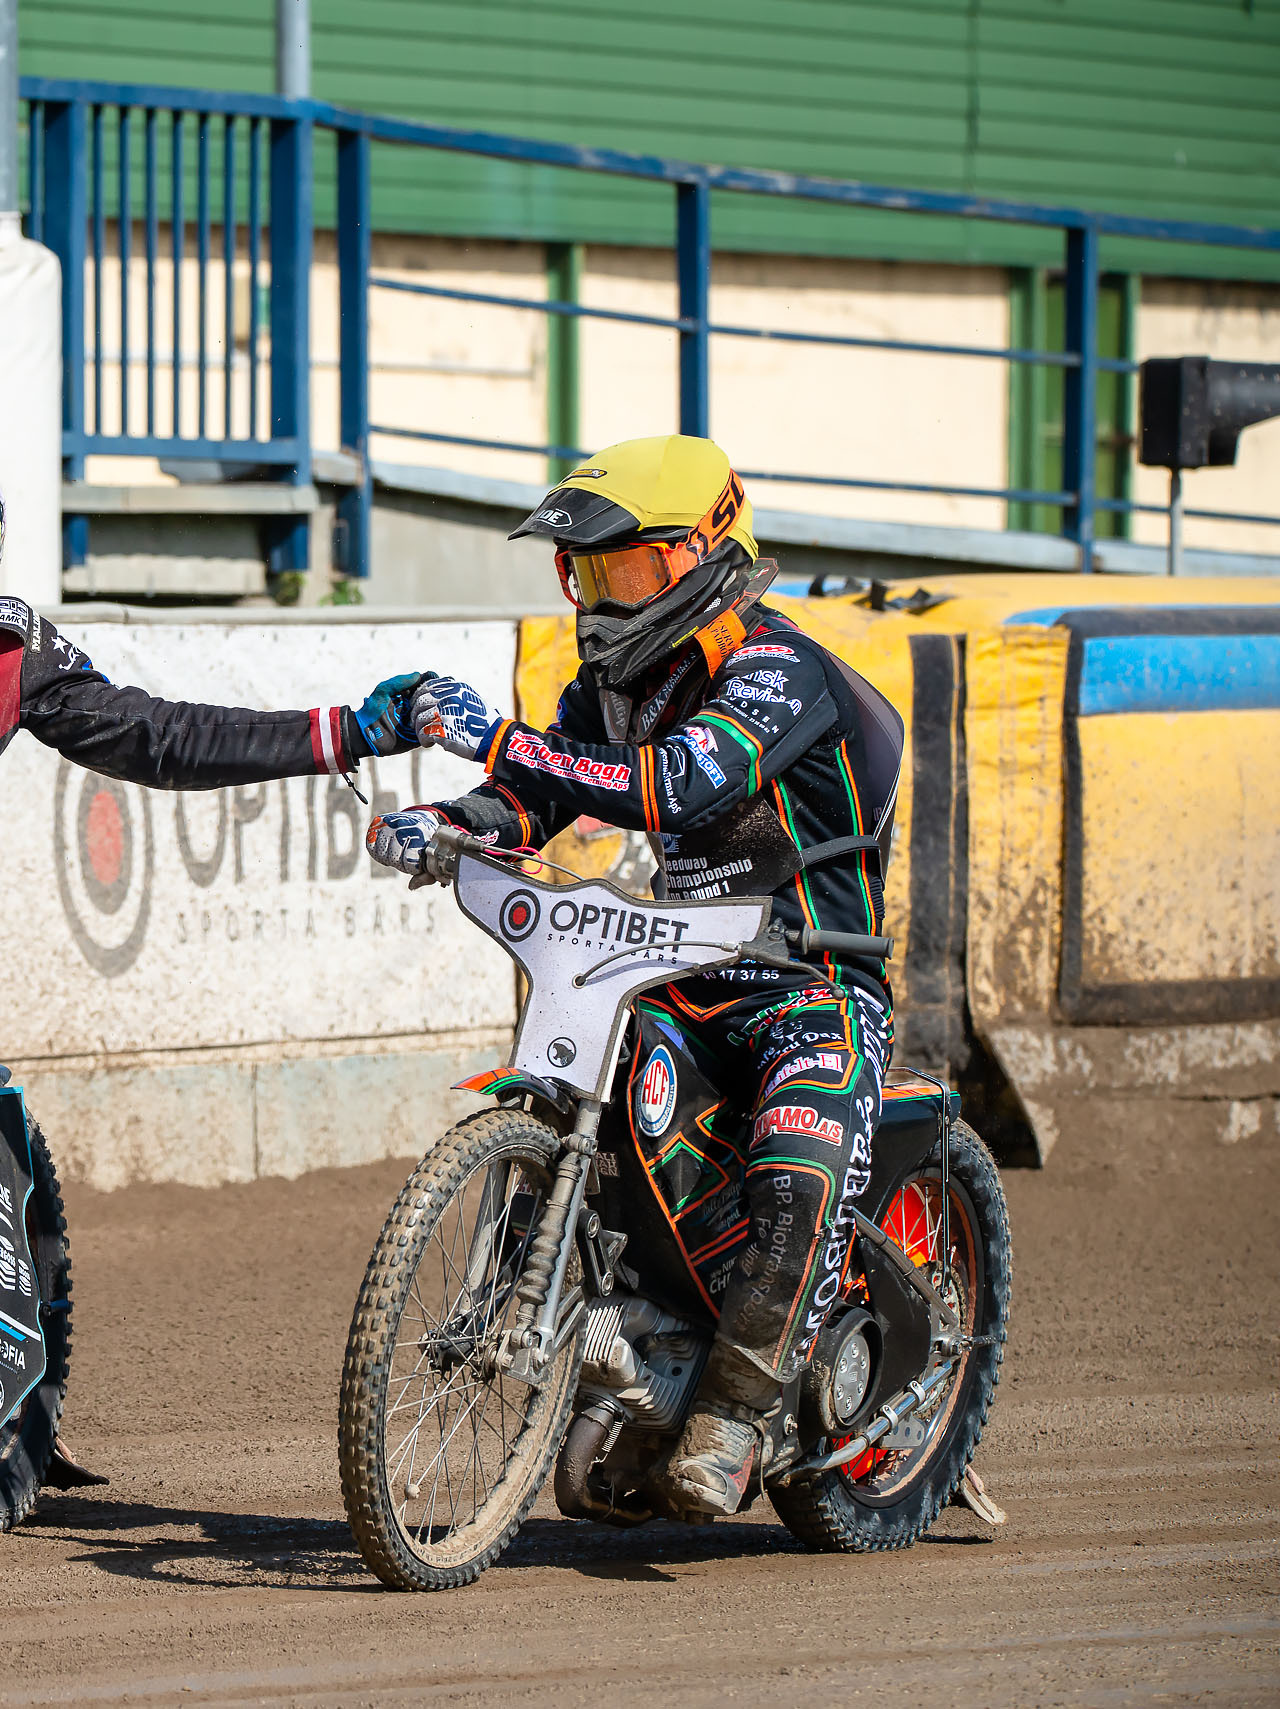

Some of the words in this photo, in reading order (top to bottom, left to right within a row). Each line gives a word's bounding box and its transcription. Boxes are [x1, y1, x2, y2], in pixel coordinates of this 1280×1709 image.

[508, 736, 573, 769] Torben
[507, 751, 536, 768] Gording
[612, 780, 629, 791] ApS
[668, 797, 682, 814] ApS
[723, 880, 731, 894] 1
[177, 907, 317, 945] SPORTA
[549, 899, 690, 954] OPTIBET
[547, 932, 616, 953] SPORTA
[719, 971, 735, 981] 17
[740, 969, 756, 980] 37
[761, 969, 780, 980] 55
[641, 1060, 669, 1106] HCF
[818, 1122, 842, 1138] A/S
